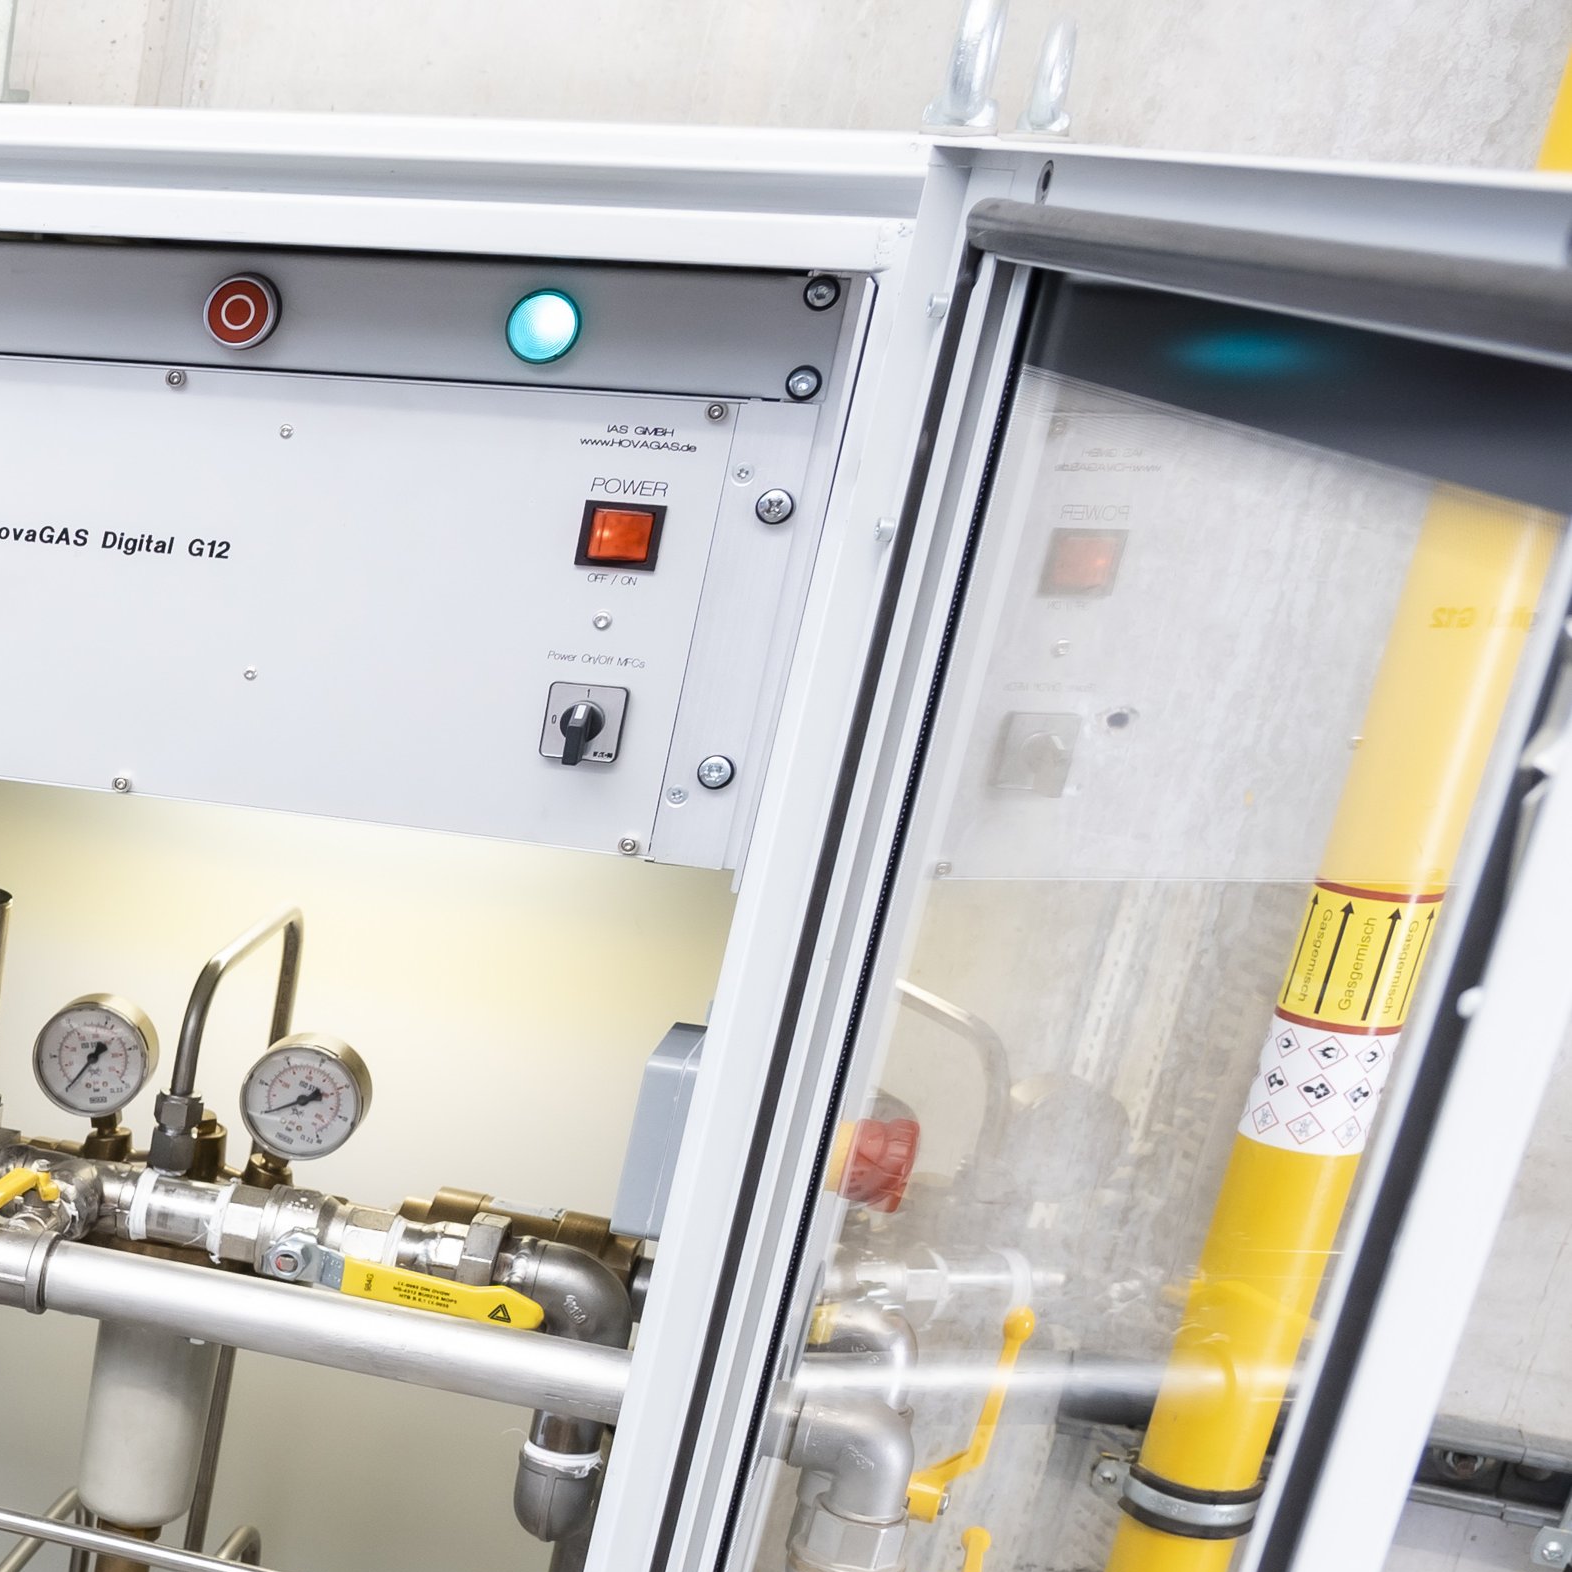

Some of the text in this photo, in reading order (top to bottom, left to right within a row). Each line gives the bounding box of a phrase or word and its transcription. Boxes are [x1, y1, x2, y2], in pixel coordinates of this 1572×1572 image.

[607, 424, 675, 437] IAS GMBH
[580, 438, 697, 454] www.HOVAGAS.de
[590, 477, 670, 498] POWER
[101, 530, 176, 556] Digital
[187, 538, 232, 560] G12
[587, 572, 609, 584] OFF
[620, 575, 638, 587] ON
[547, 649, 646, 670] Power On/Off MFCs
[551, 714, 558, 725] 0
[1298, 908, 1334, 1003] Gasgemisch
[1337, 915, 1379, 1012] Gasgemisch
[1383, 919, 1420, 1015] Gasgemisch
